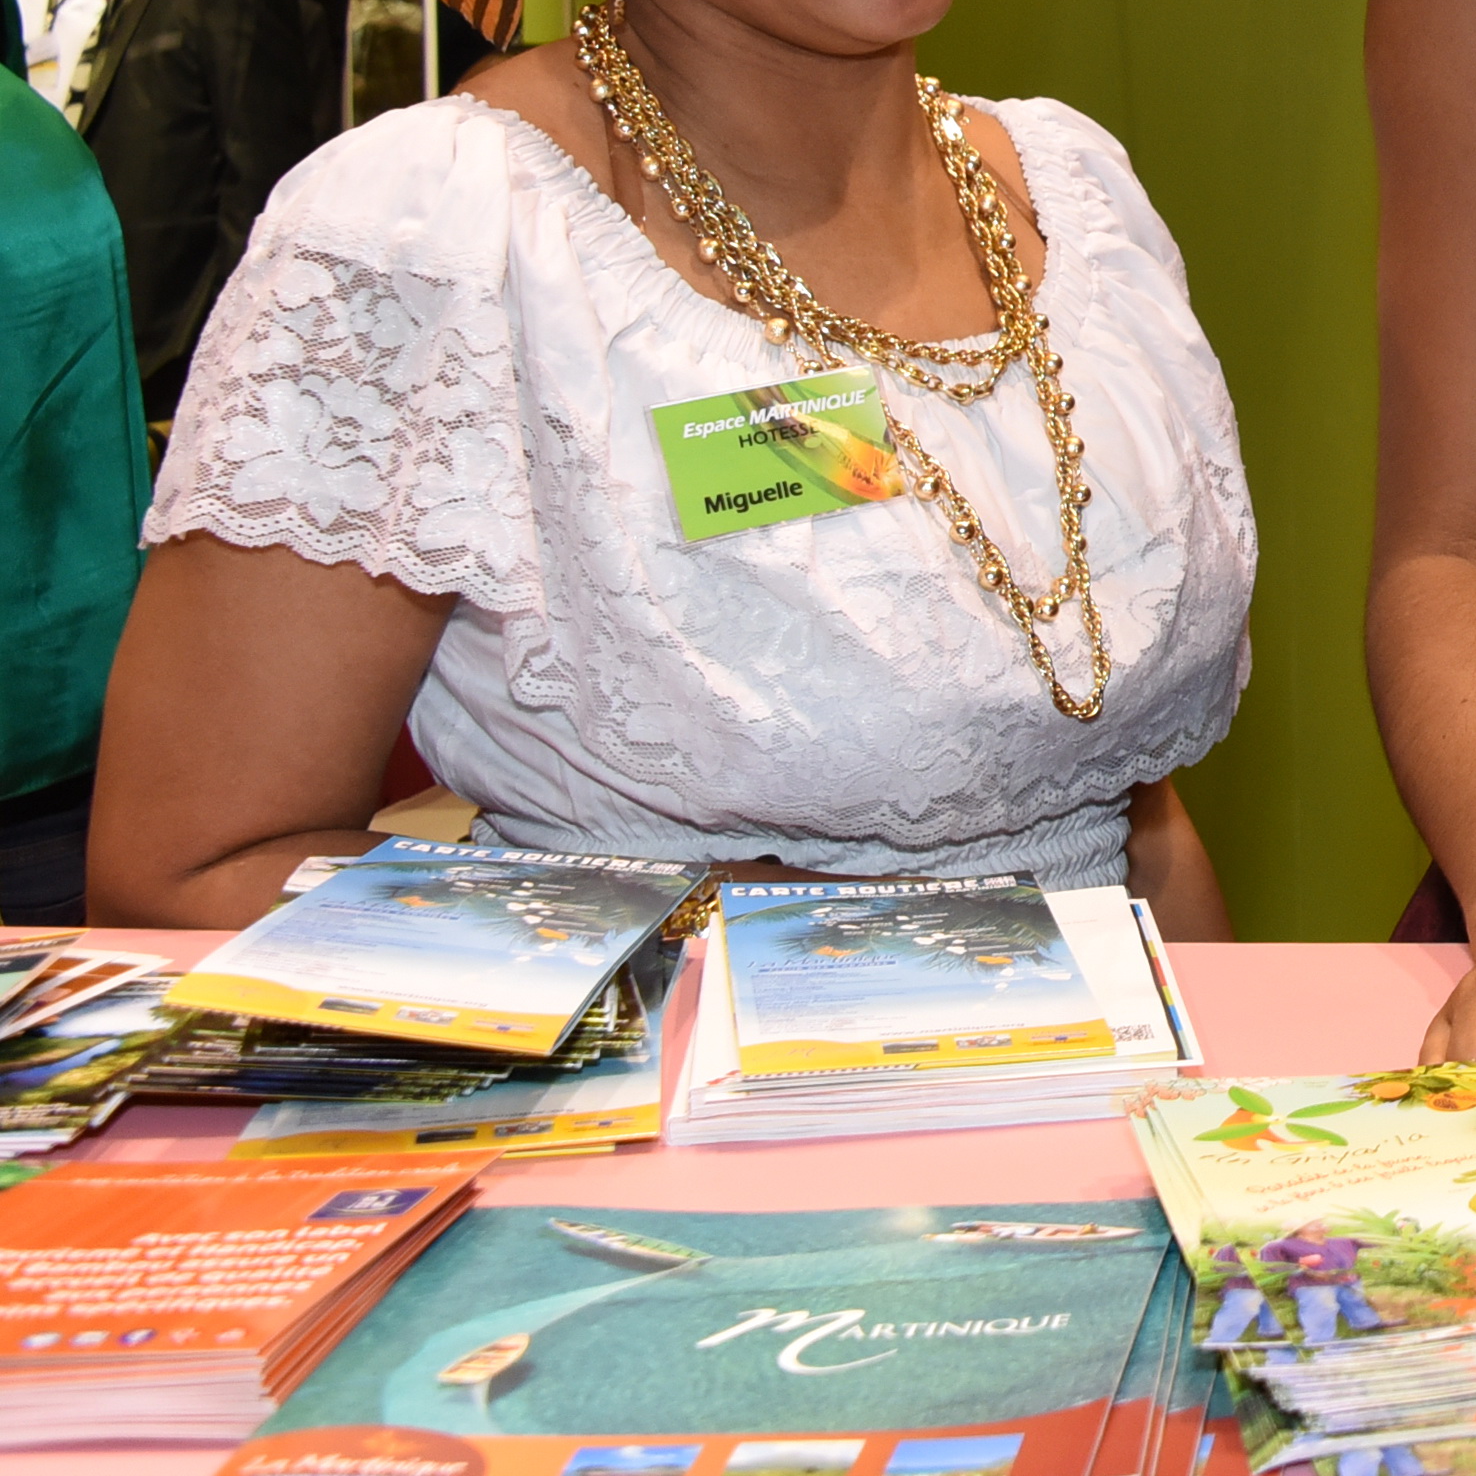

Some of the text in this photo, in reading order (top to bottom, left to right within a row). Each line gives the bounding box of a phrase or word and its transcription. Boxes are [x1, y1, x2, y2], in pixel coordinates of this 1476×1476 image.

[683, 389, 867, 440] Espace MARTINIQUE
[738, 422, 820, 449] HOTESSE
[704, 481, 804, 515] Miguelle
[393, 840, 495, 859] CARTE
[730, 886, 826, 899] CARTE
